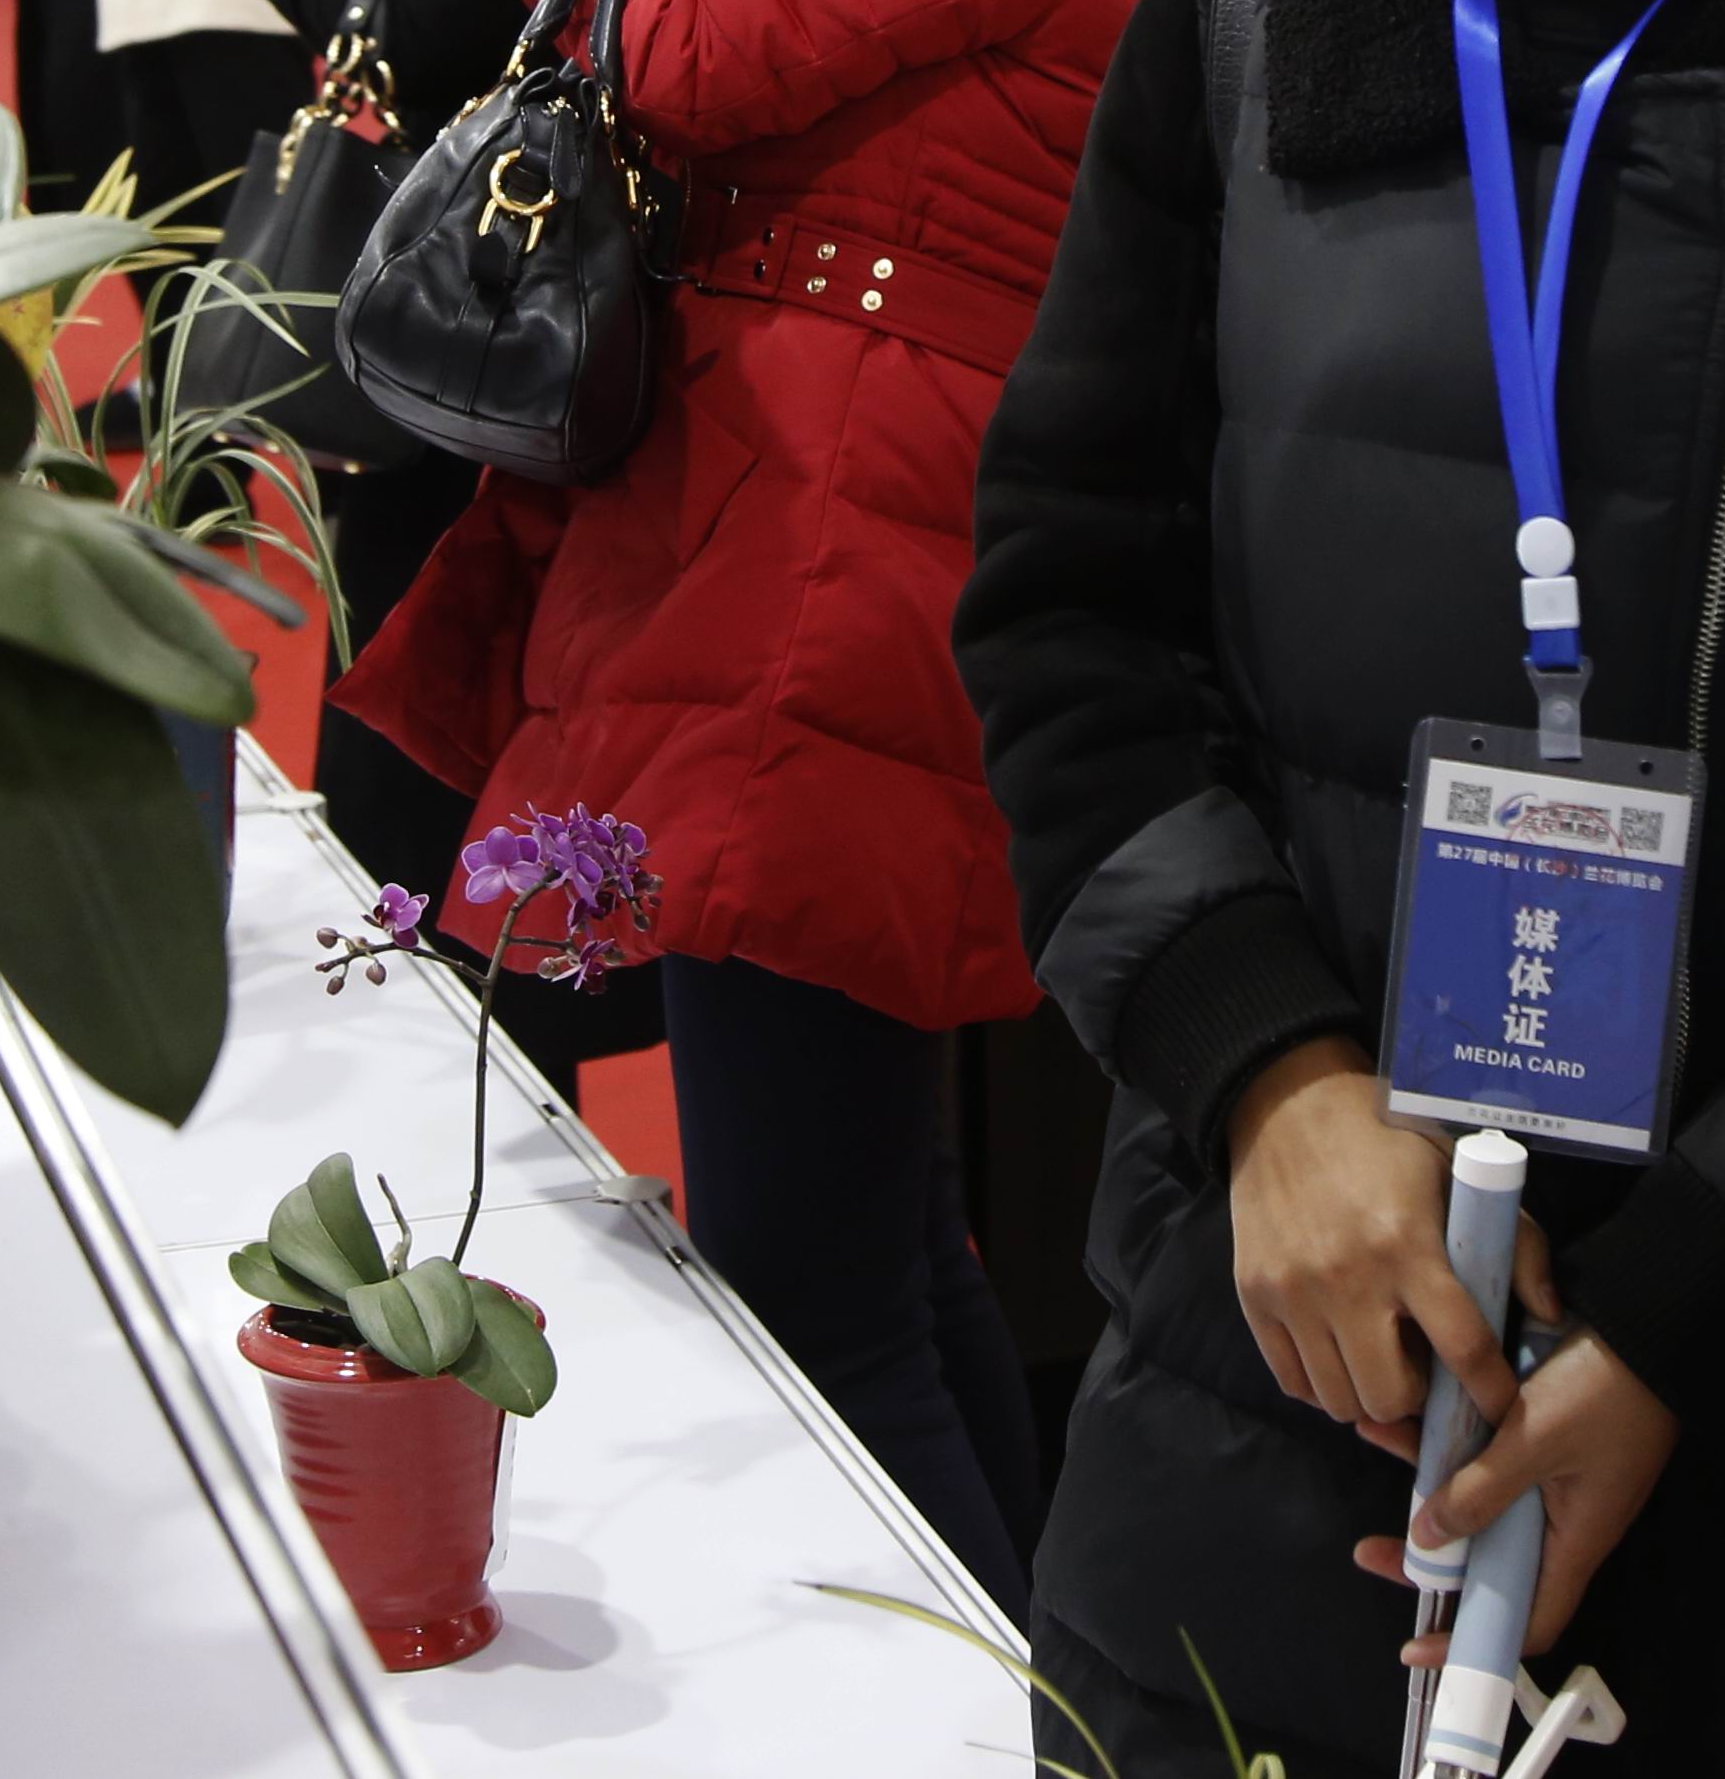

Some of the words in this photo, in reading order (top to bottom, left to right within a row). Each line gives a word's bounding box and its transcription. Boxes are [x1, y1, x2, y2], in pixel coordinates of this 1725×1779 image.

[1502, 906, 1561, 1049] 媒体证
[1453, 1043, 1523, 1071] MEDIA
[1526, 1057, 1586, 1080] CARD
